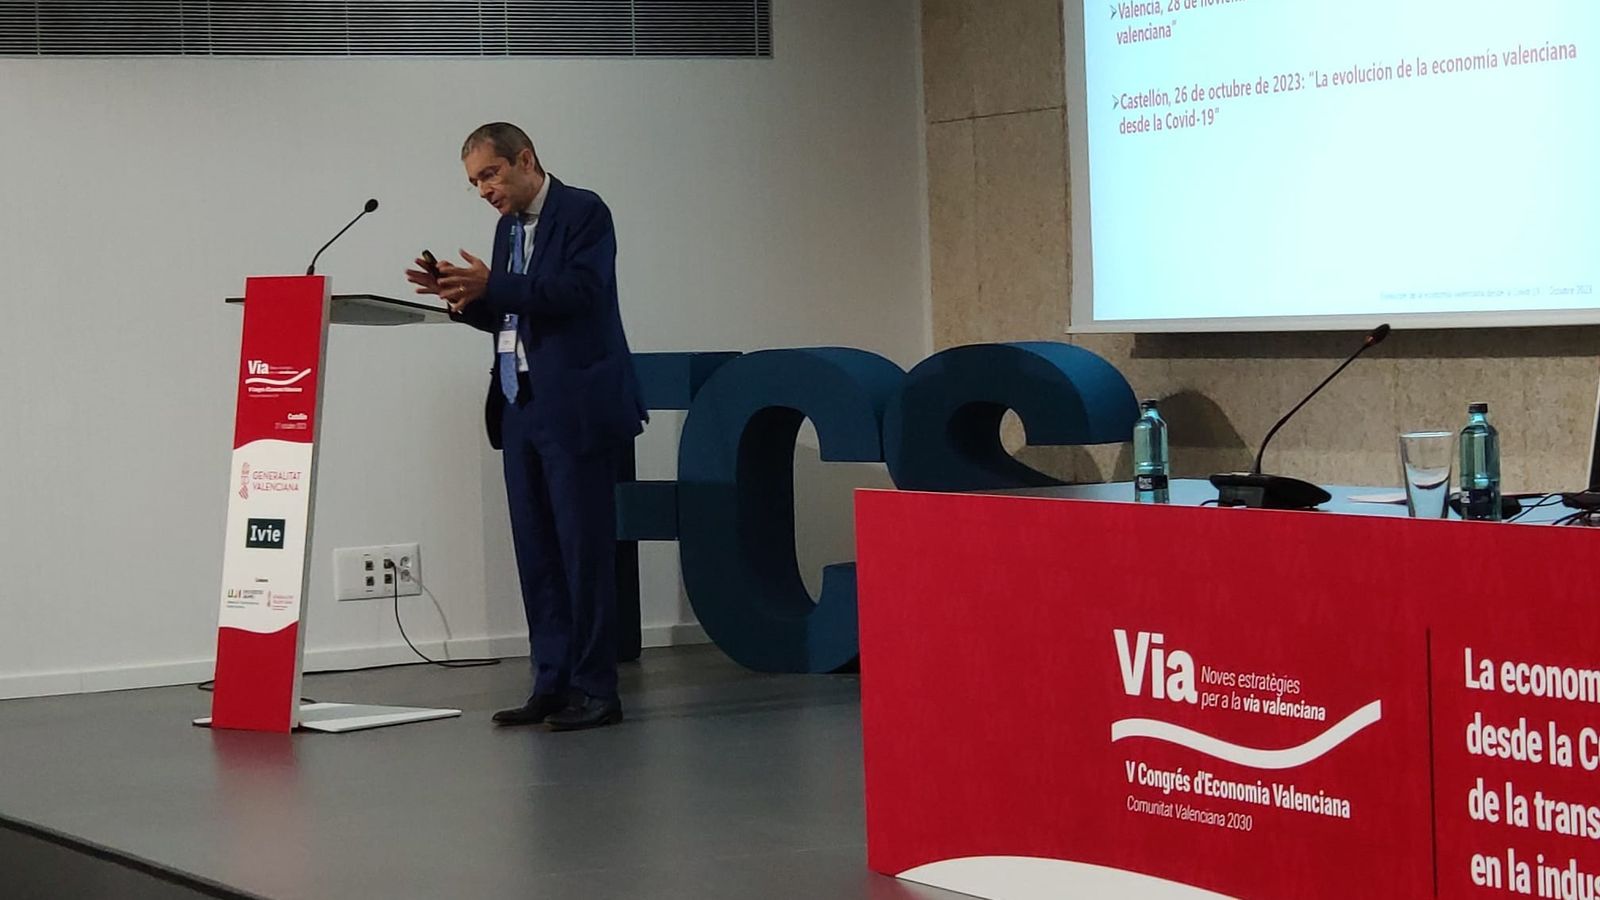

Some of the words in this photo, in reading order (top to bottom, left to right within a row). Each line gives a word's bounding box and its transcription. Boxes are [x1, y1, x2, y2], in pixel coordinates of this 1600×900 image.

[1118, 0, 1164, 20] Valencia,
[1120, 88, 1171, 110] Castellón,
[1175, 86, 1188, 104] 26
[1191, 84, 1205, 101] de
[1208, 80, 1252, 100] octubre
[1255, 76, 1269, 95] de
[1273, 72, 1305, 93] 2023:
[1332, 60, 1392, 86] evolución
[1396, 59, 1412, 78] de
[1416, 57, 1427, 76] la
[1432, 48, 1498, 74] economía
[1502, 41, 1577, 66] valenciana
[1119, 115, 1150, 134] desde
[1153, 113, 1162, 131] la
[247, 360, 270, 375] Via
[253, 471, 302, 480] GENERALITAT
[253, 482, 299, 491] VALENCIANA
[249, 524, 281, 543] Ivie
[1113, 628, 1198, 704] Via
[1201, 665, 1236, 687] Noves
[1238, 673, 1301, 697] estratègies
[1464, 647, 1495, 691] La
[1500, 661, 1600, 704] econom
[1201, 692, 1219, 710] per
[1221, 695, 1229, 708] a
[1231, 691, 1241, 710] la
[1243, 693, 1260, 713] via
[1262, 696, 1326, 721] valenciana
[1466, 711, 1543, 764] desde
[1548, 720, 1573, 768] la
[1578, 727, 1600, 771] C
[1125, 760, 1136, 783] V
[1137, 762, 1191, 795] Congrés
[1193, 770, 1270, 806] d'Economia
[1272, 783, 1351, 819] Valenciana
[1127, 795, 1173, 818] Comunitat
[1175, 803, 1226, 827] Valenciana
[1227, 812, 1253, 832] 2030
[1468, 777, 1500, 823] de
[1505, 782, 1529, 828] la
[1533, 791, 1600, 840] trans
[1471, 853, 1502, 889] en
[1507, 848, 1531, 894] la
